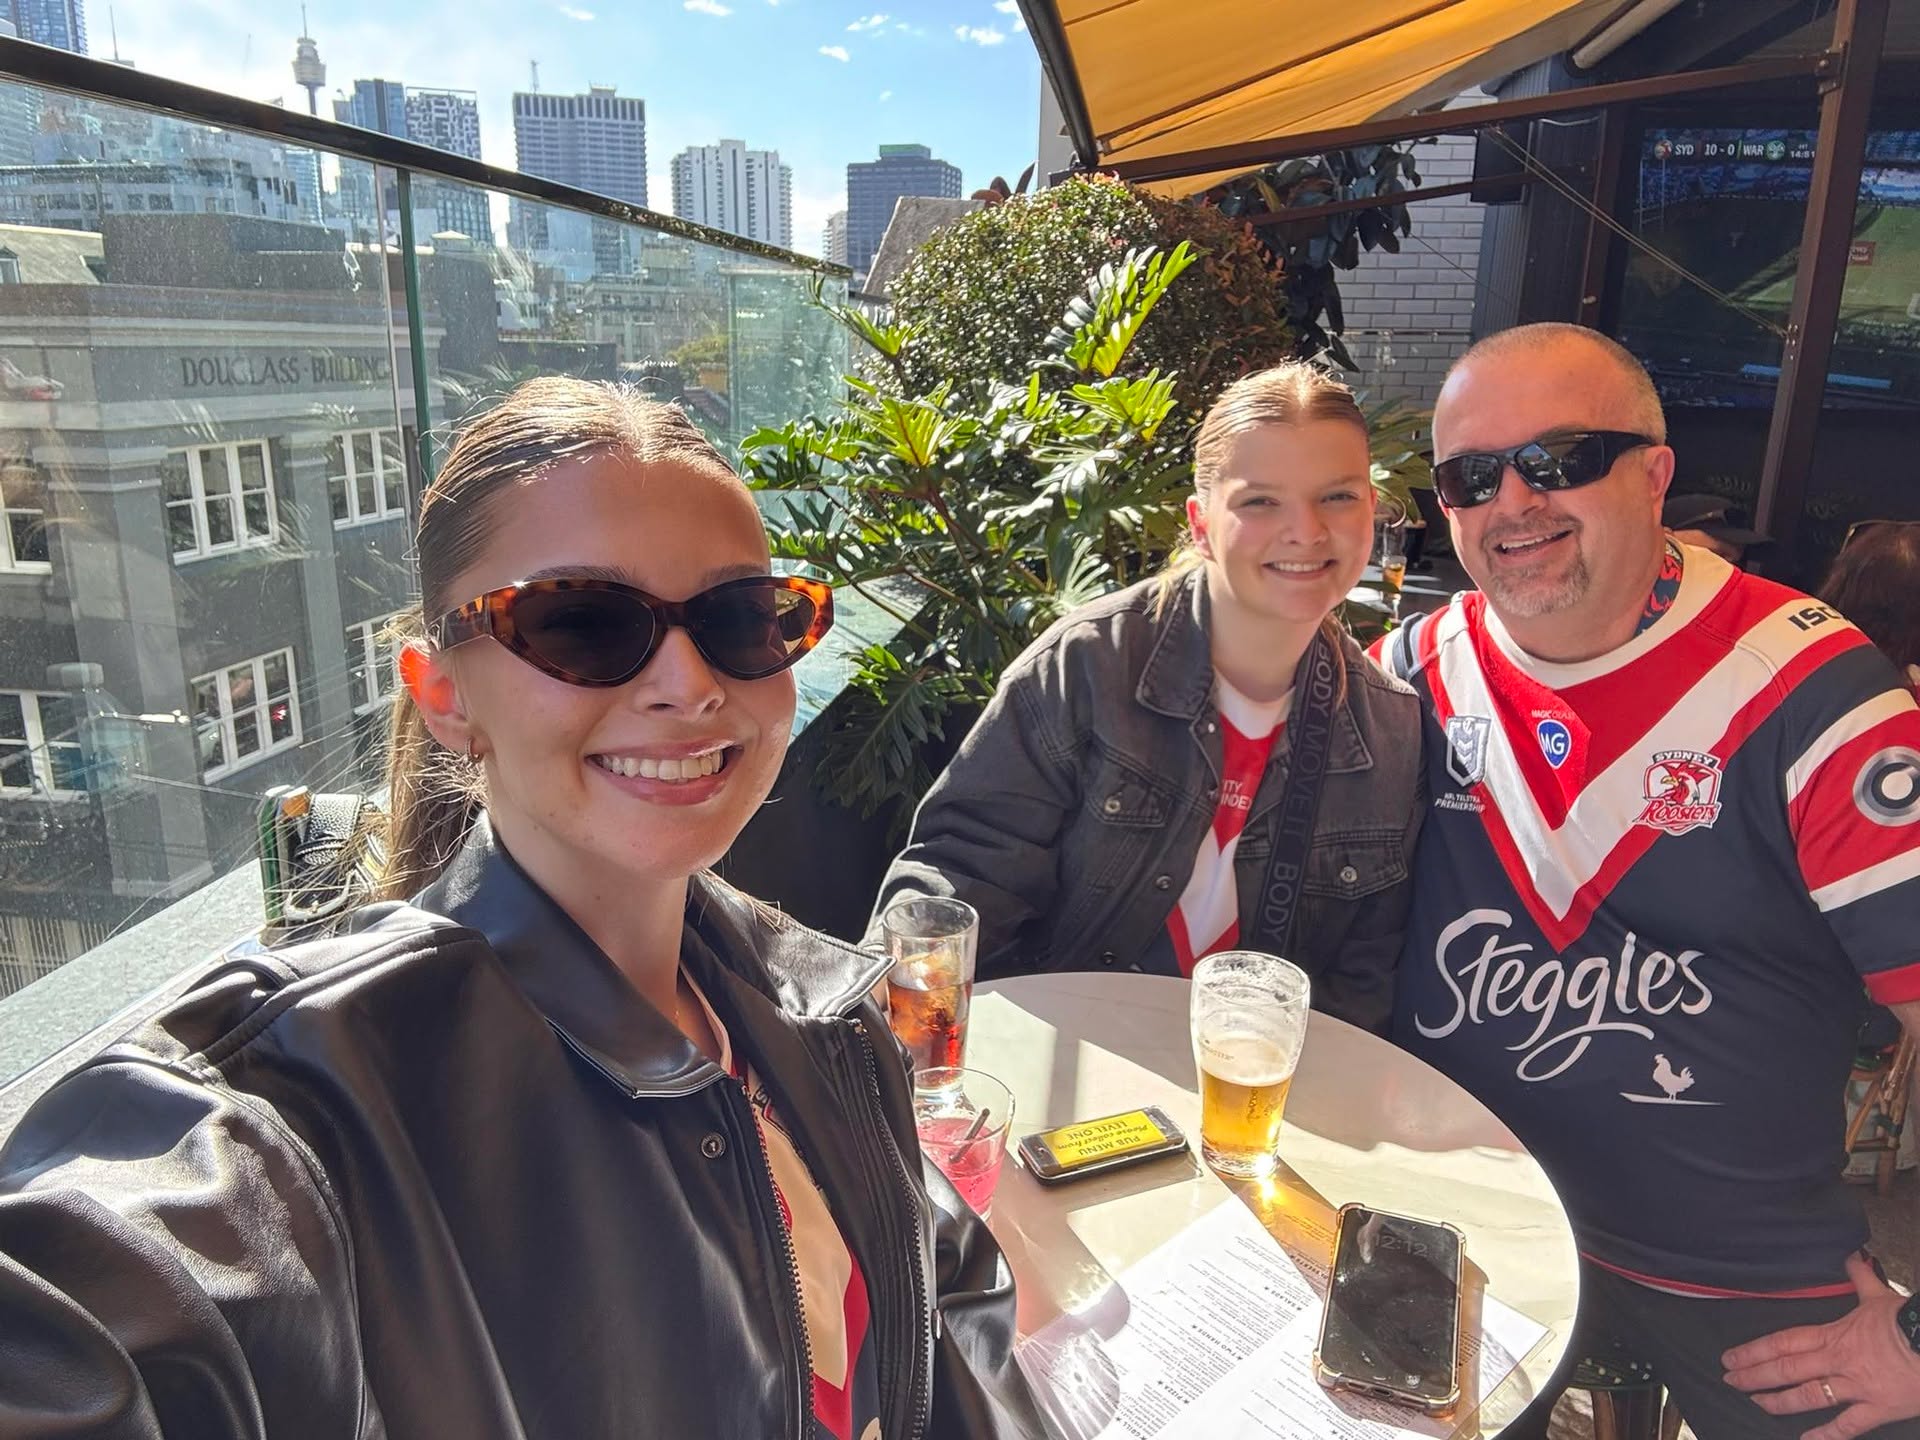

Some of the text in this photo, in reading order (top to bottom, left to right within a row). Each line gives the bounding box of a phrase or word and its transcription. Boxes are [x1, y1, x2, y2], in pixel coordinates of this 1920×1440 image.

[1674, 143, 1693, 157] SYD
[1704, 143, 1717, 156] 10
[1727, 144, 1736, 156] 0
[1743, 144, 1764, 157] WAR
[180, 353, 389, 387] DOUGLASS BUILDING
[1310, 642, 1333, 718] BODY
[1540, 732, 1565, 755] MG
[1655, 750, 1713, 765] SYDNEY
[1434, 798, 1486, 814] PREMIERSHIP
[1261, 861, 1299, 942] BODY
[1414, 908, 1713, 1082] Steggles
[1057, 1124, 1148, 1150] Please collect from
[1067, 1121, 1128, 1141] LEVEL ONE
[1078, 1135, 1141, 1156] PUB MENU
[1375, 1233, 1428, 1257] 12:12
[1271, 1290, 1297, 1307] SALADS
[1164, 1385, 1183, 1401] PIZZA
